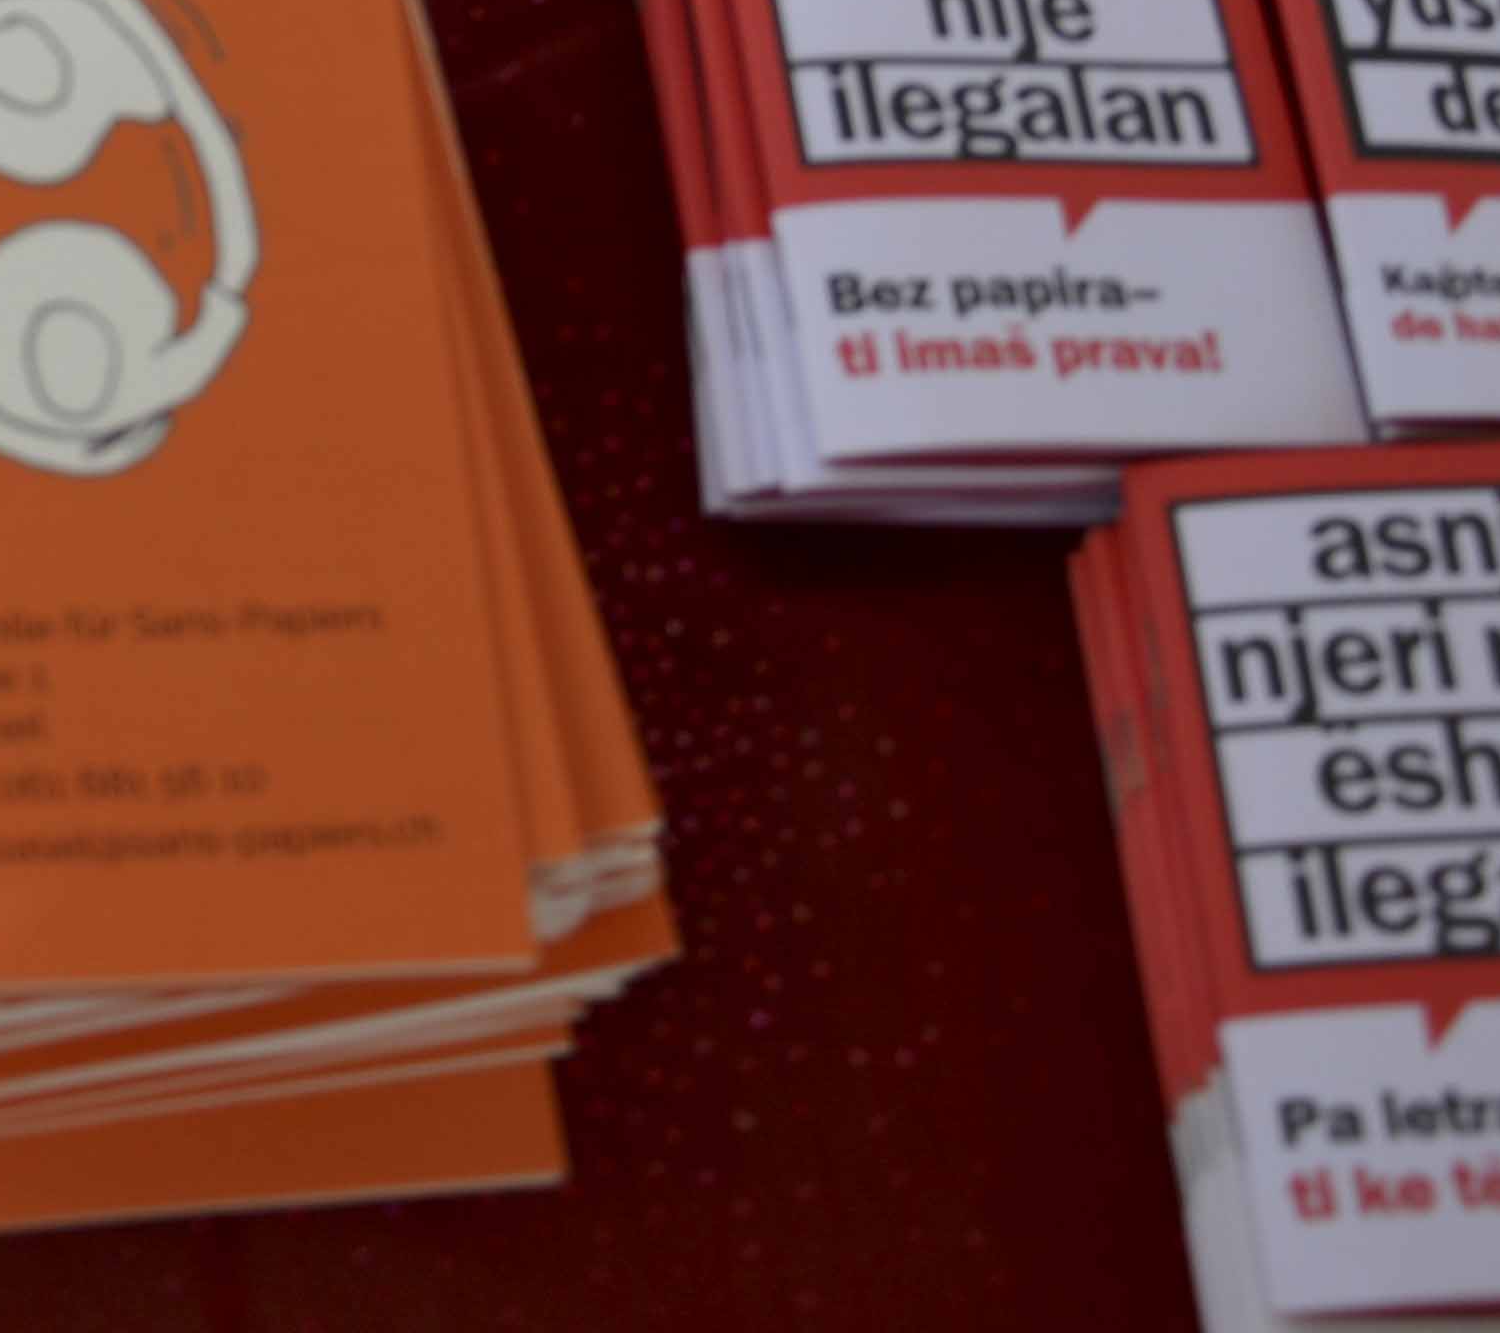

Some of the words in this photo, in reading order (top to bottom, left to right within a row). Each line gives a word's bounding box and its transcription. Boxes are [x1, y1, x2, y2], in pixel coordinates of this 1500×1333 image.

[828, 65, 1219, 161] ilegalan
[827, 272, 932, 315] Bez
[1390, 312, 1440, 341] de
[835, 335, 879, 378] ti
[1054, 329, 1222, 380] prava!
[1219, 601, 1459, 724] njeri
[1278, 1097, 1364, 1146] Pa
[1288, 1171, 1336, 1220] ti
[1358, 1163, 1436, 1215] ke
